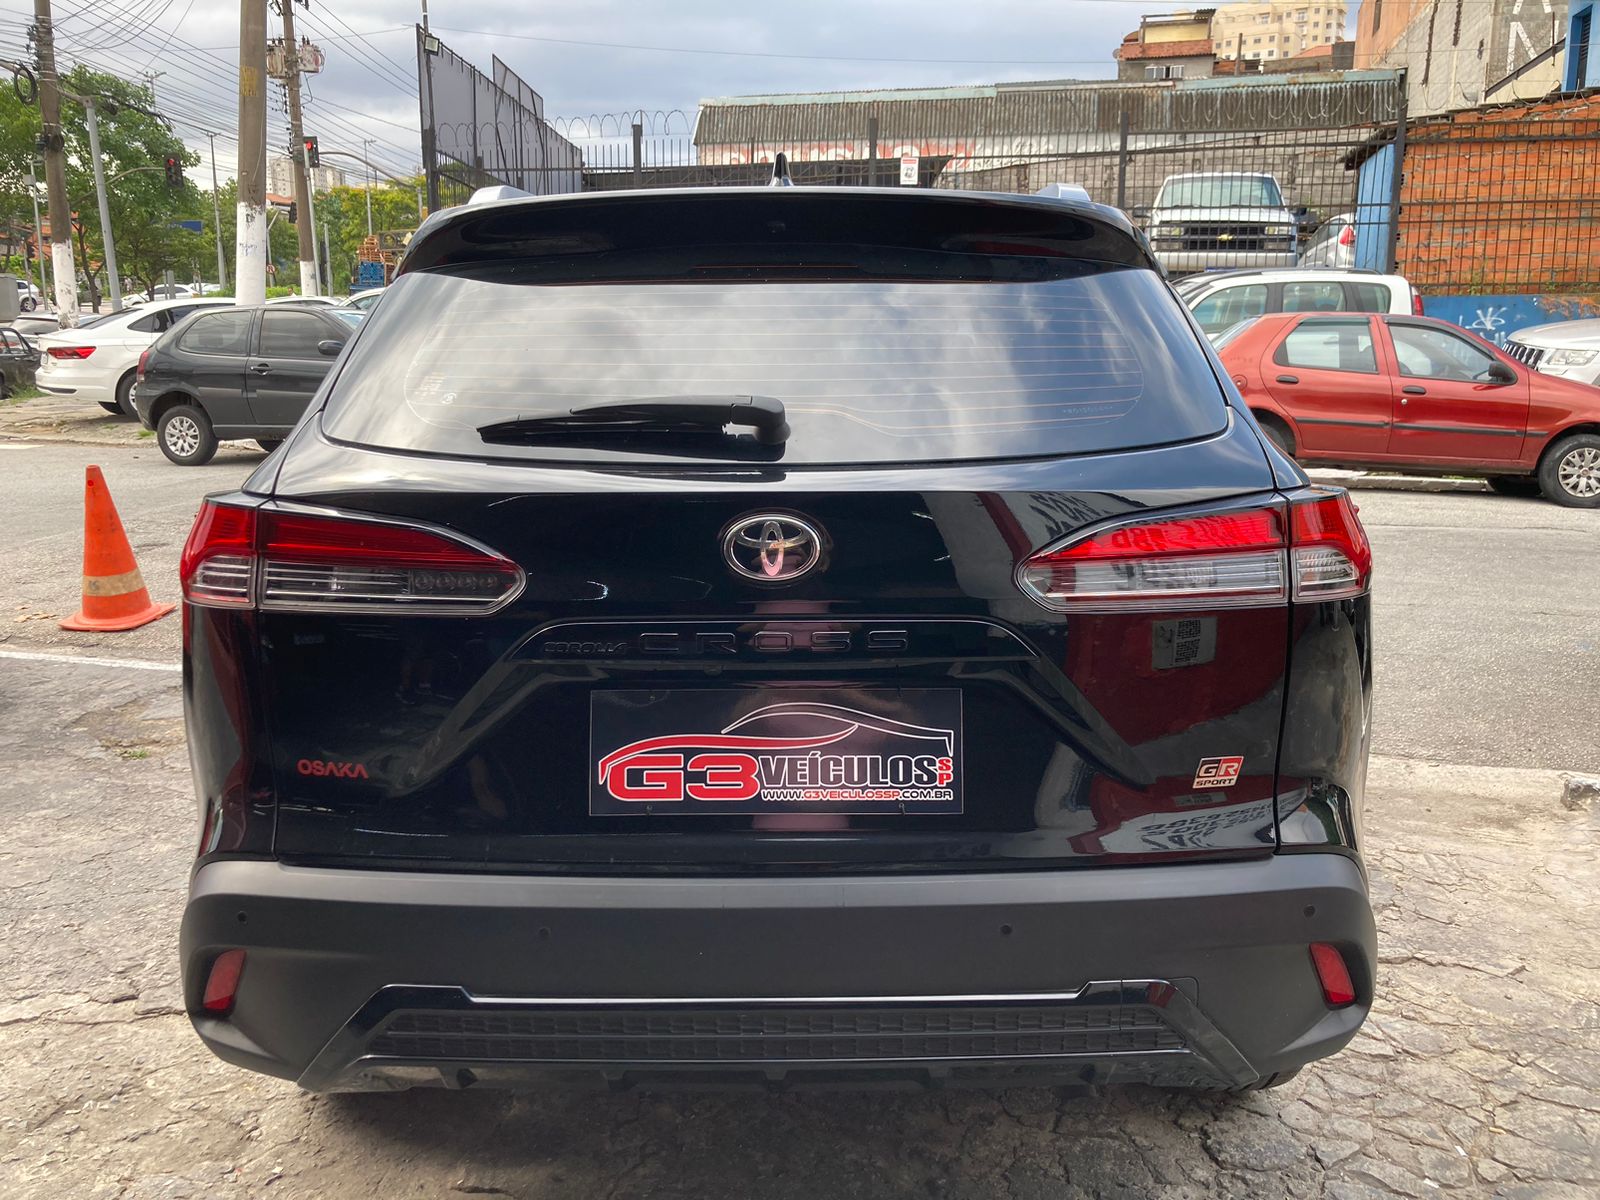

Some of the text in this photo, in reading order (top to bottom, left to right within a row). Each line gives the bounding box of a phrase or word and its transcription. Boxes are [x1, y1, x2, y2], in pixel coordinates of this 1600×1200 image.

[544, 630, 908, 655] COROLLA CROSS
[297, 759, 368, 779] OSAKA
[607, 753, 761, 801] G3
[759, 751, 938, 788] VEÍCULOS
[1198, 762, 1240, 777] GR
[1195, 778, 1235, 787] SPORT
[762, 788, 954, 801] WWW.G3VEICULOSSP.COM.BR
